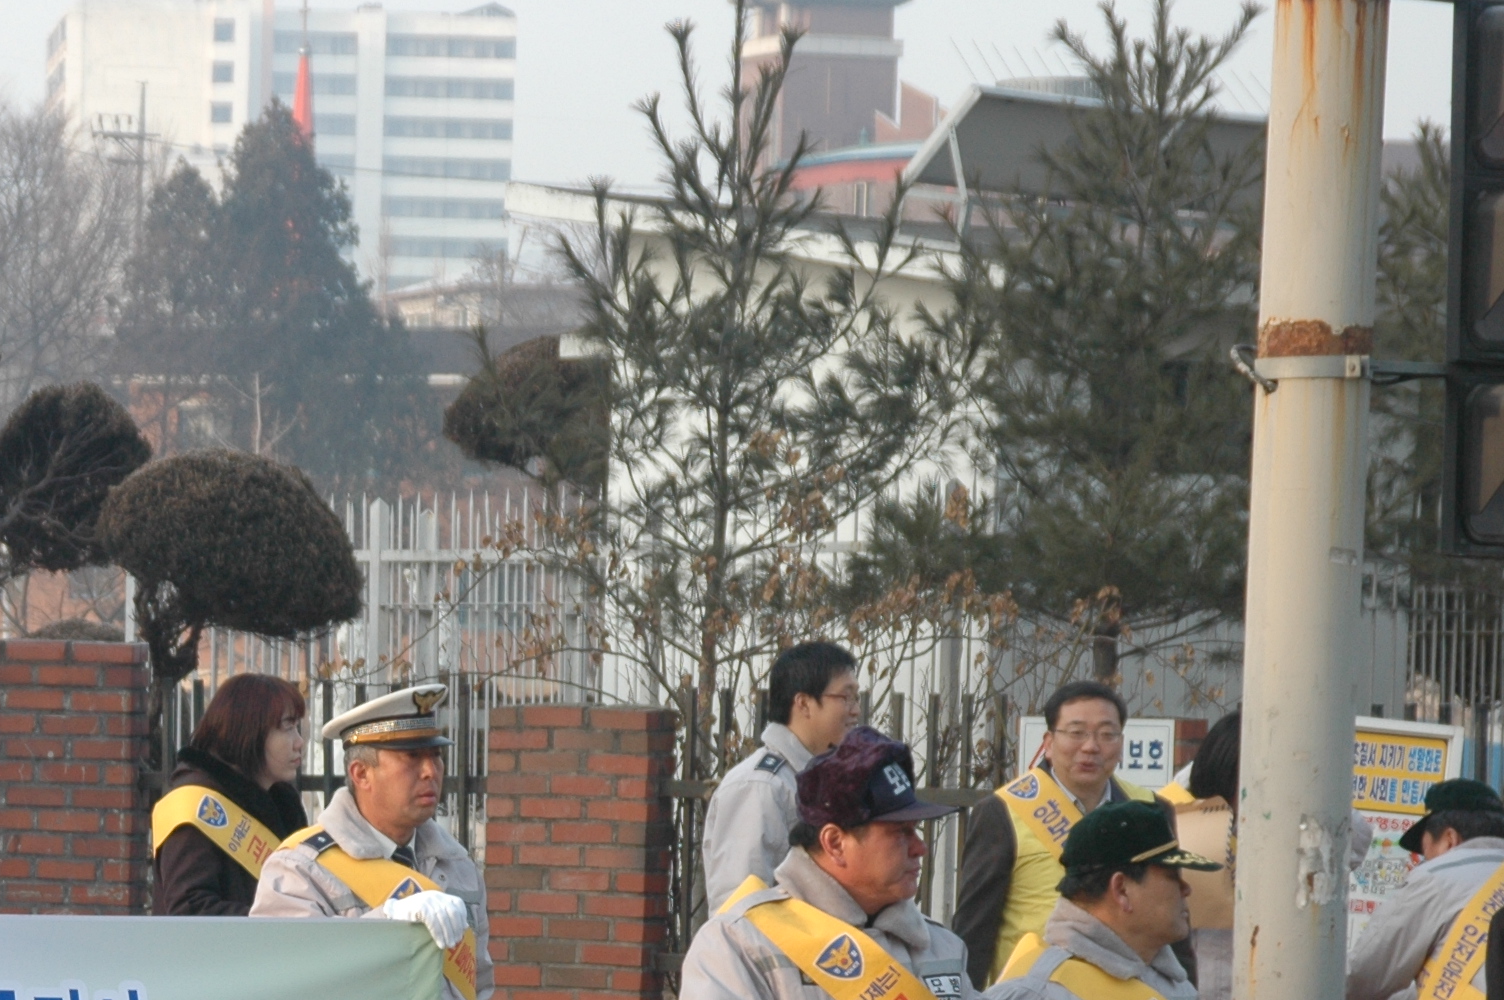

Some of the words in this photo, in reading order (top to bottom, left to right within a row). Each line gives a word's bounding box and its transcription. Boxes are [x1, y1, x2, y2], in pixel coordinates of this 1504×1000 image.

[1129, 739, 1163, 770] 보호
[1379, 744, 1406, 770] 지키기
[1370, 776, 1398, 803] 사회를
